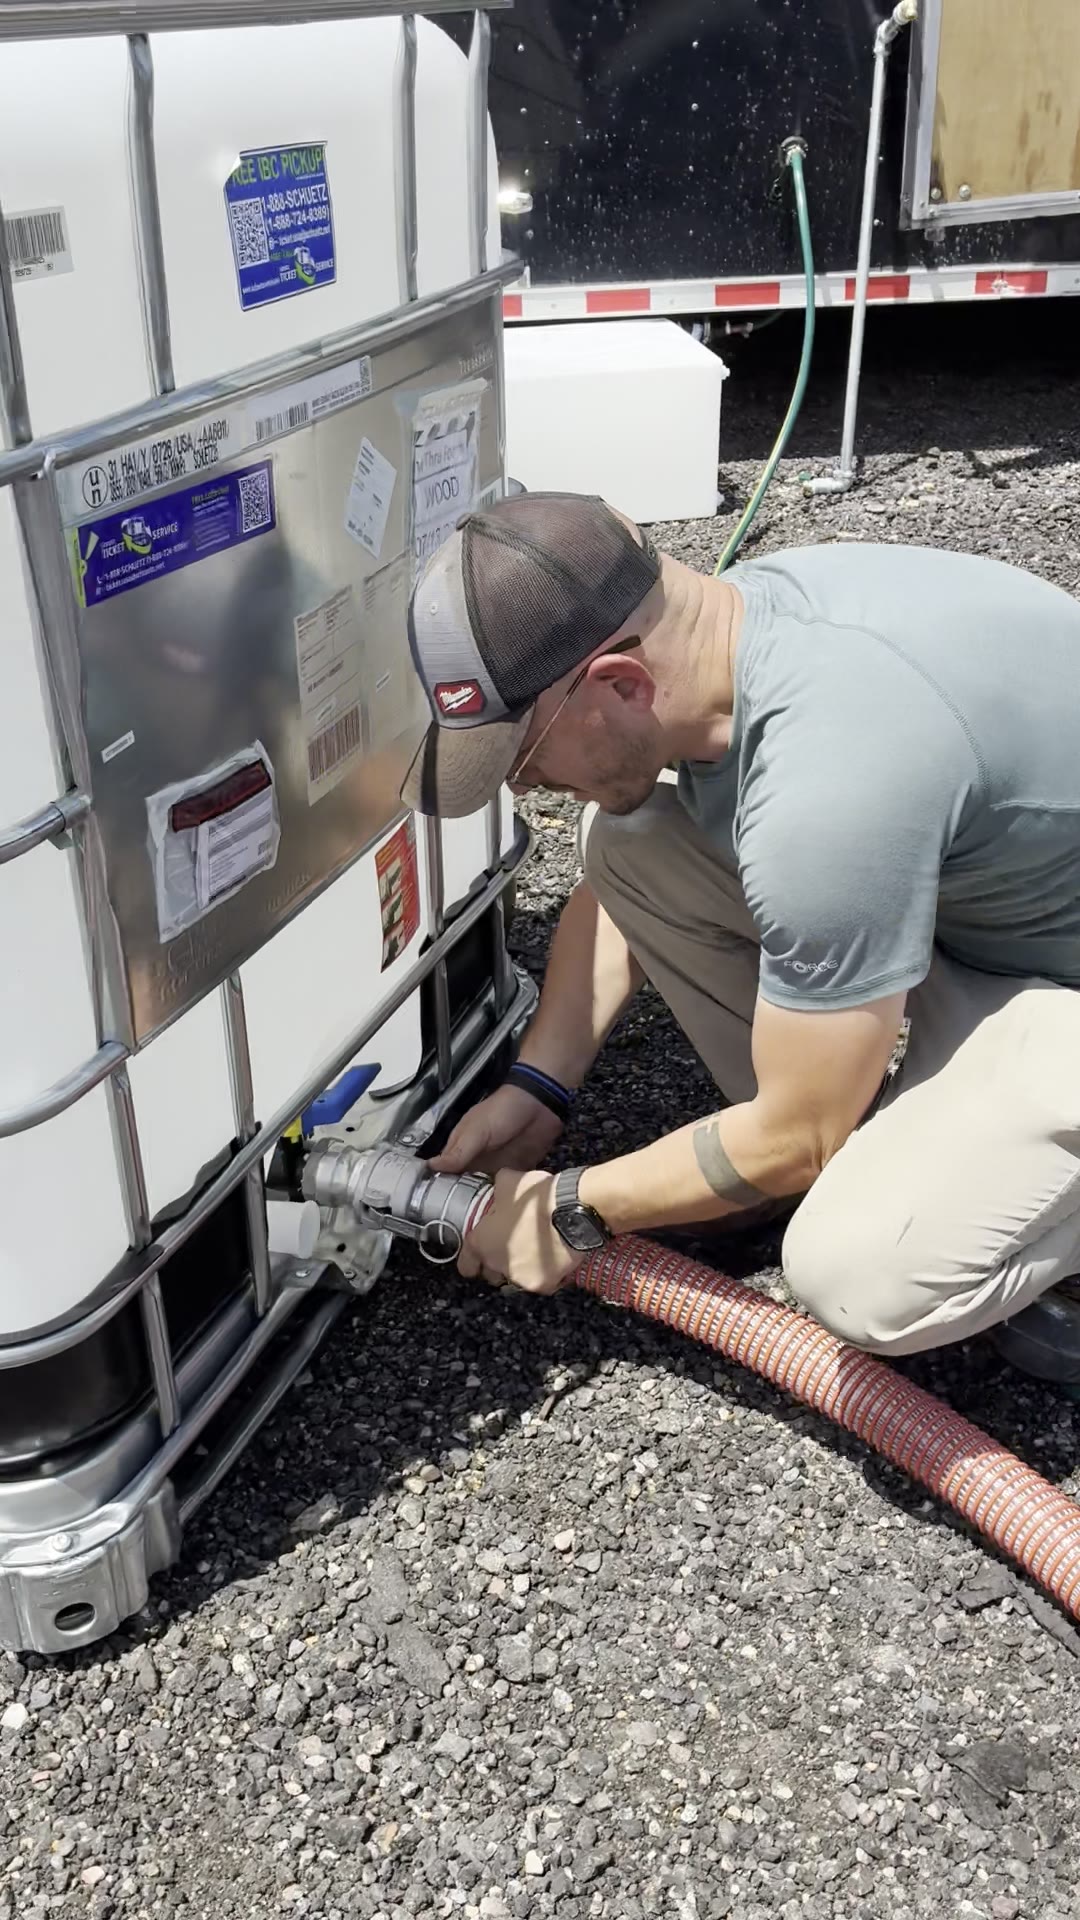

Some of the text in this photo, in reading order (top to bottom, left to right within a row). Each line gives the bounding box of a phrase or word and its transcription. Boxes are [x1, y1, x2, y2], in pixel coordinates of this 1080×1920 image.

[257, 154, 280, 181] IBC
[263, 183, 328, 213] 1-888-SCHUETZ
[424, 476, 460, 508] WOOD
[103, 541, 125, 558] TICKET
[152, 522, 178, 540] SERVICE
[784, 960, 839, 974] FORCE
